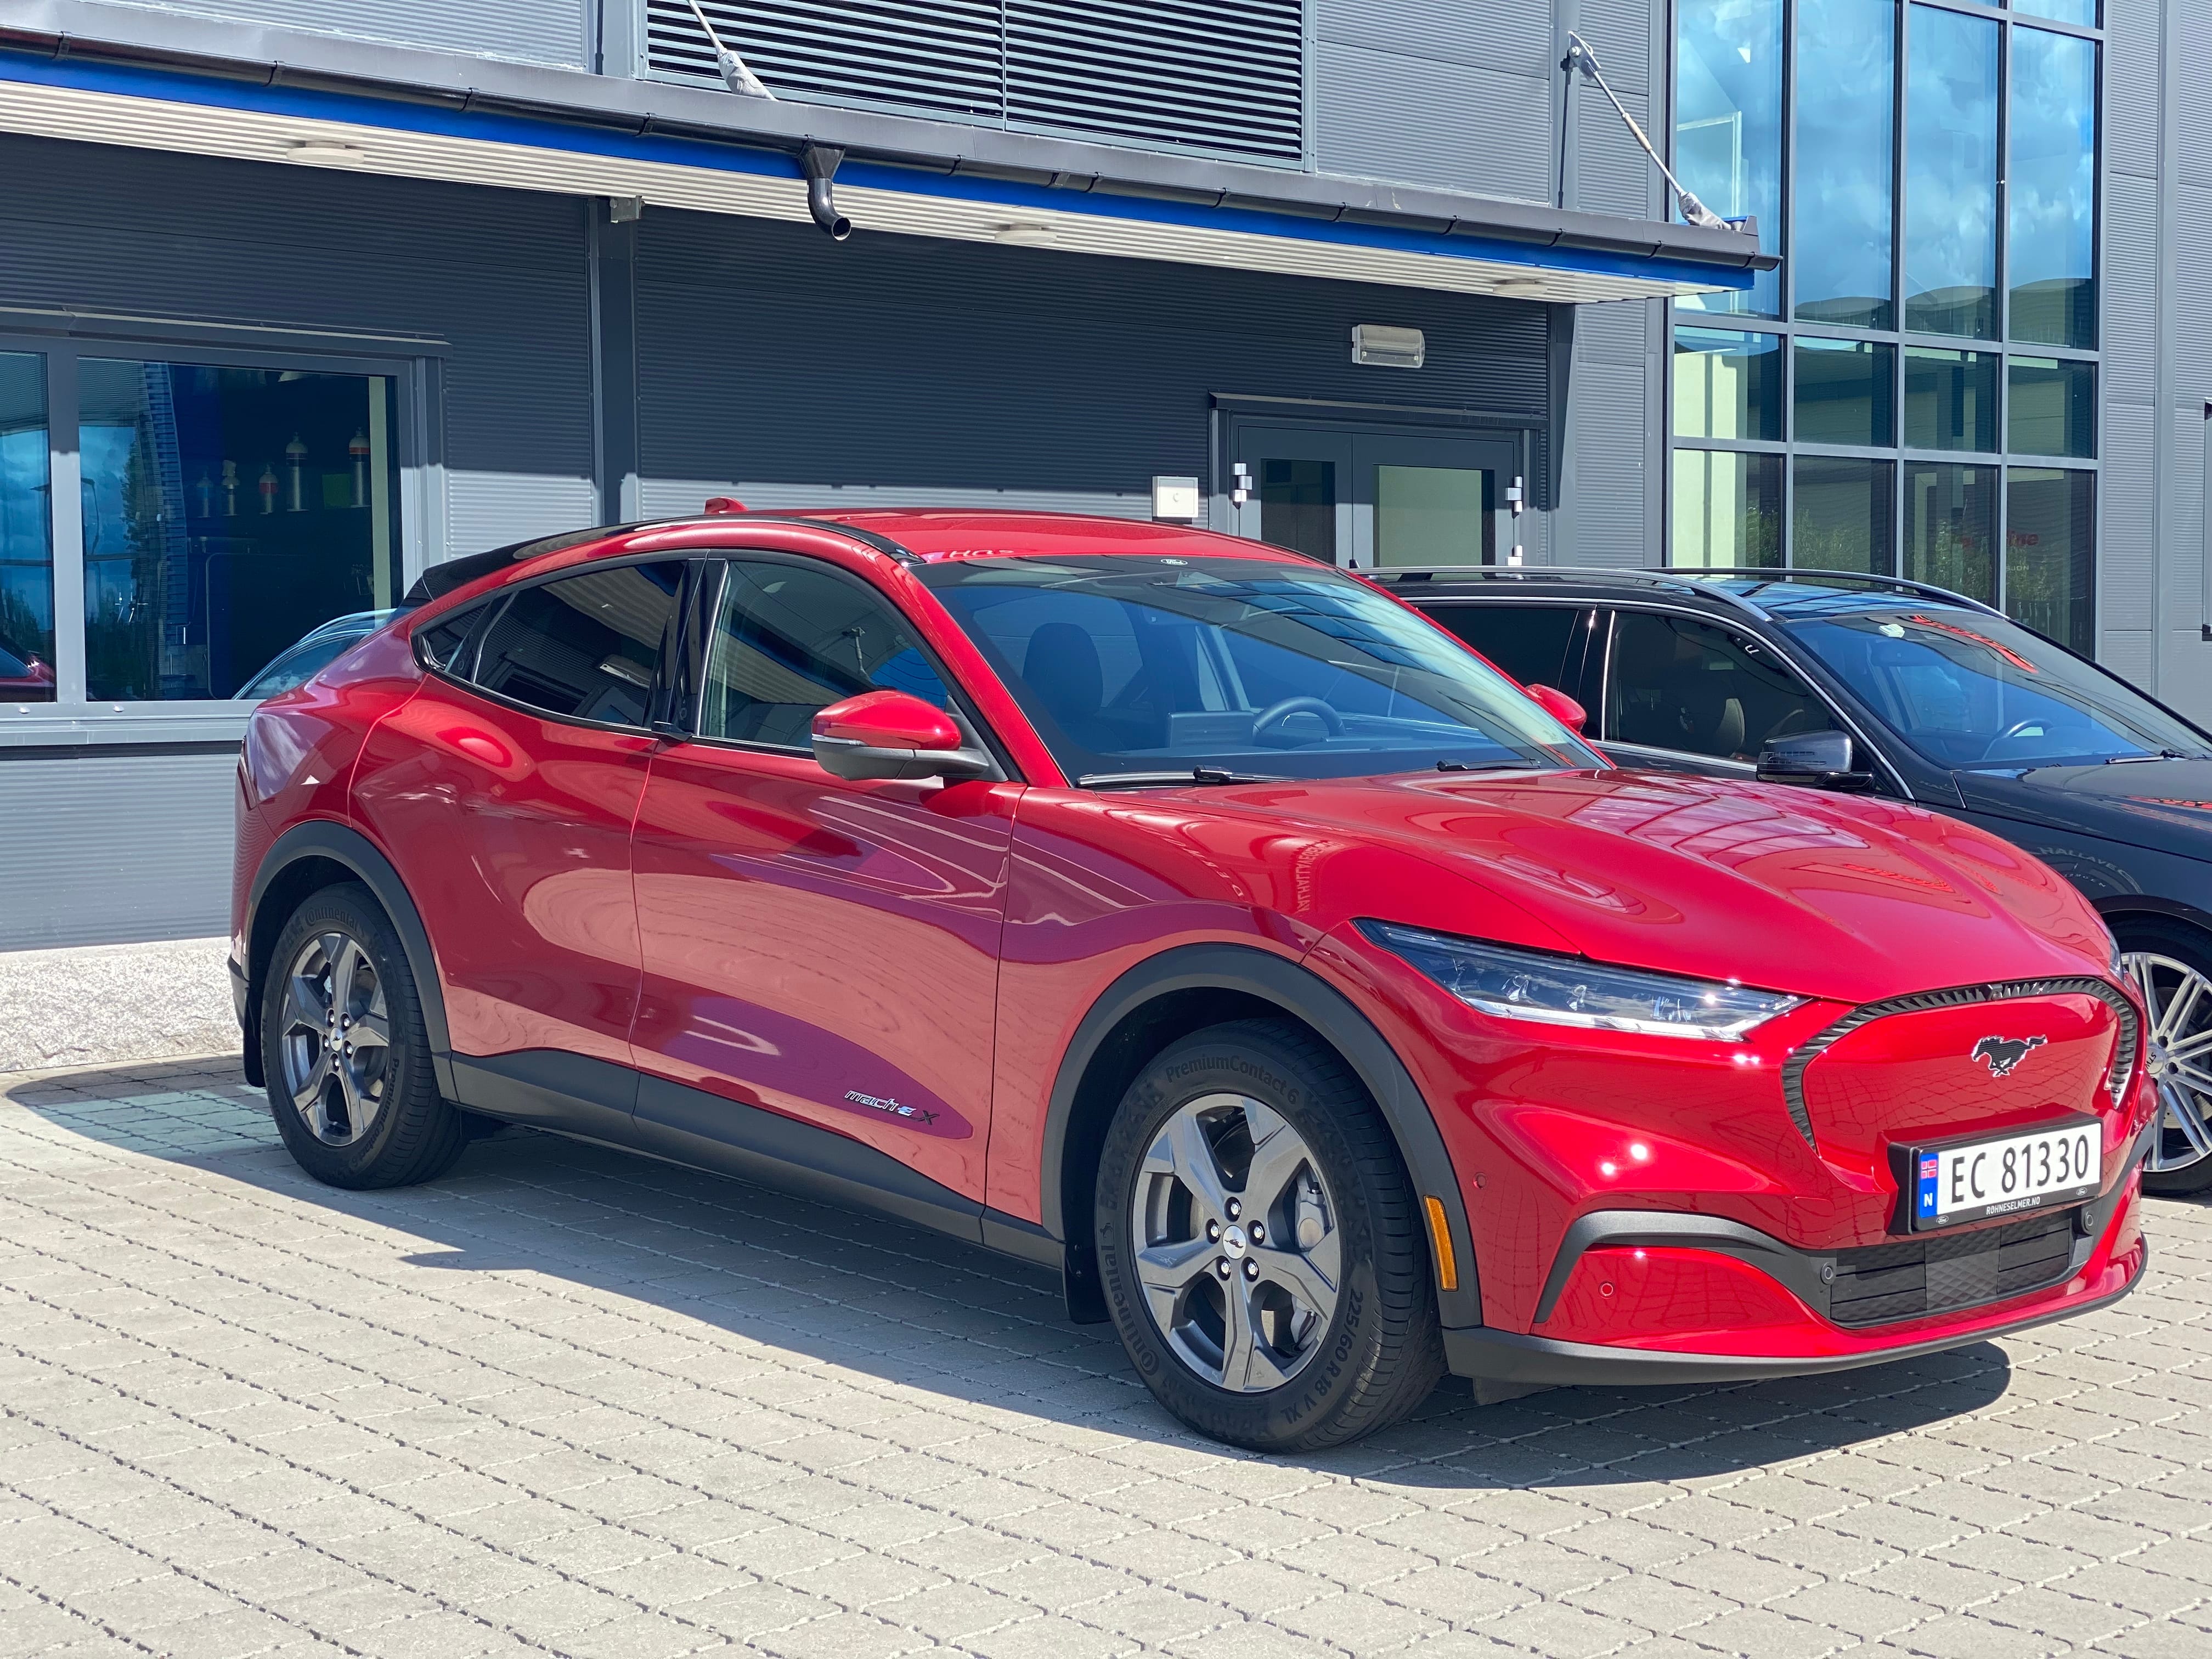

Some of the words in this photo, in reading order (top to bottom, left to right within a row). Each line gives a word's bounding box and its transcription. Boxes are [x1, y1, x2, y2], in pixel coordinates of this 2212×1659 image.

[1165, 1053, 1288, 1096] PremiumContact
[1286, 1088, 1300, 1105] 6
[1951, 1152, 1986, 1204] EC
[2001, 1134, 2089, 1194] 81330
[1923, 1192, 1933, 1207] N
[1101, 1243, 1160, 1376] Continental
[1335, 1288, 1364, 1362] 225/60
[1325, 1360, 1341, 1378] R
[1314, 1374, 1333, 1397] 18
[1279, 1402, 1303, 1424] XL
[1303, 1393, 1317, 1411] V
